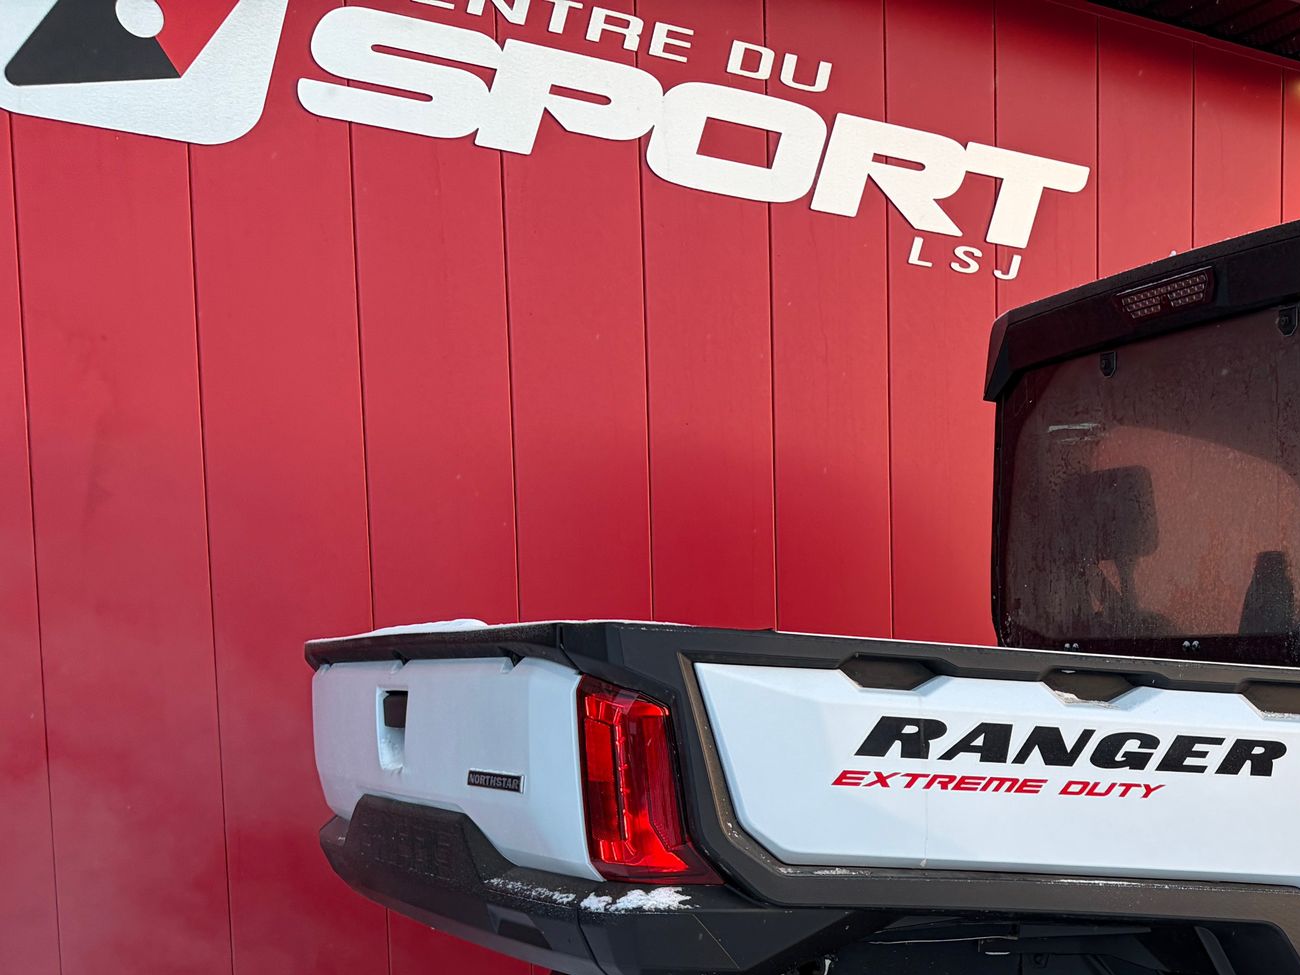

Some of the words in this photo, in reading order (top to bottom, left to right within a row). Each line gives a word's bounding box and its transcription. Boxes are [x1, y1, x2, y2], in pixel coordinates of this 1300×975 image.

[410, 0, 694, 64] NTRE
[726, 39, 832, 93] DU
[296, 6, 1091, 249] SPORT
[907, 236, 1023, 281] LSJ
[854, 715, 1287, 777] RANGER
[468, 772, 519, 790] NORTHSTAR
[831, 769, 1049, 794] EXTREME
[1058, 779, 1167, 799] DUTY
